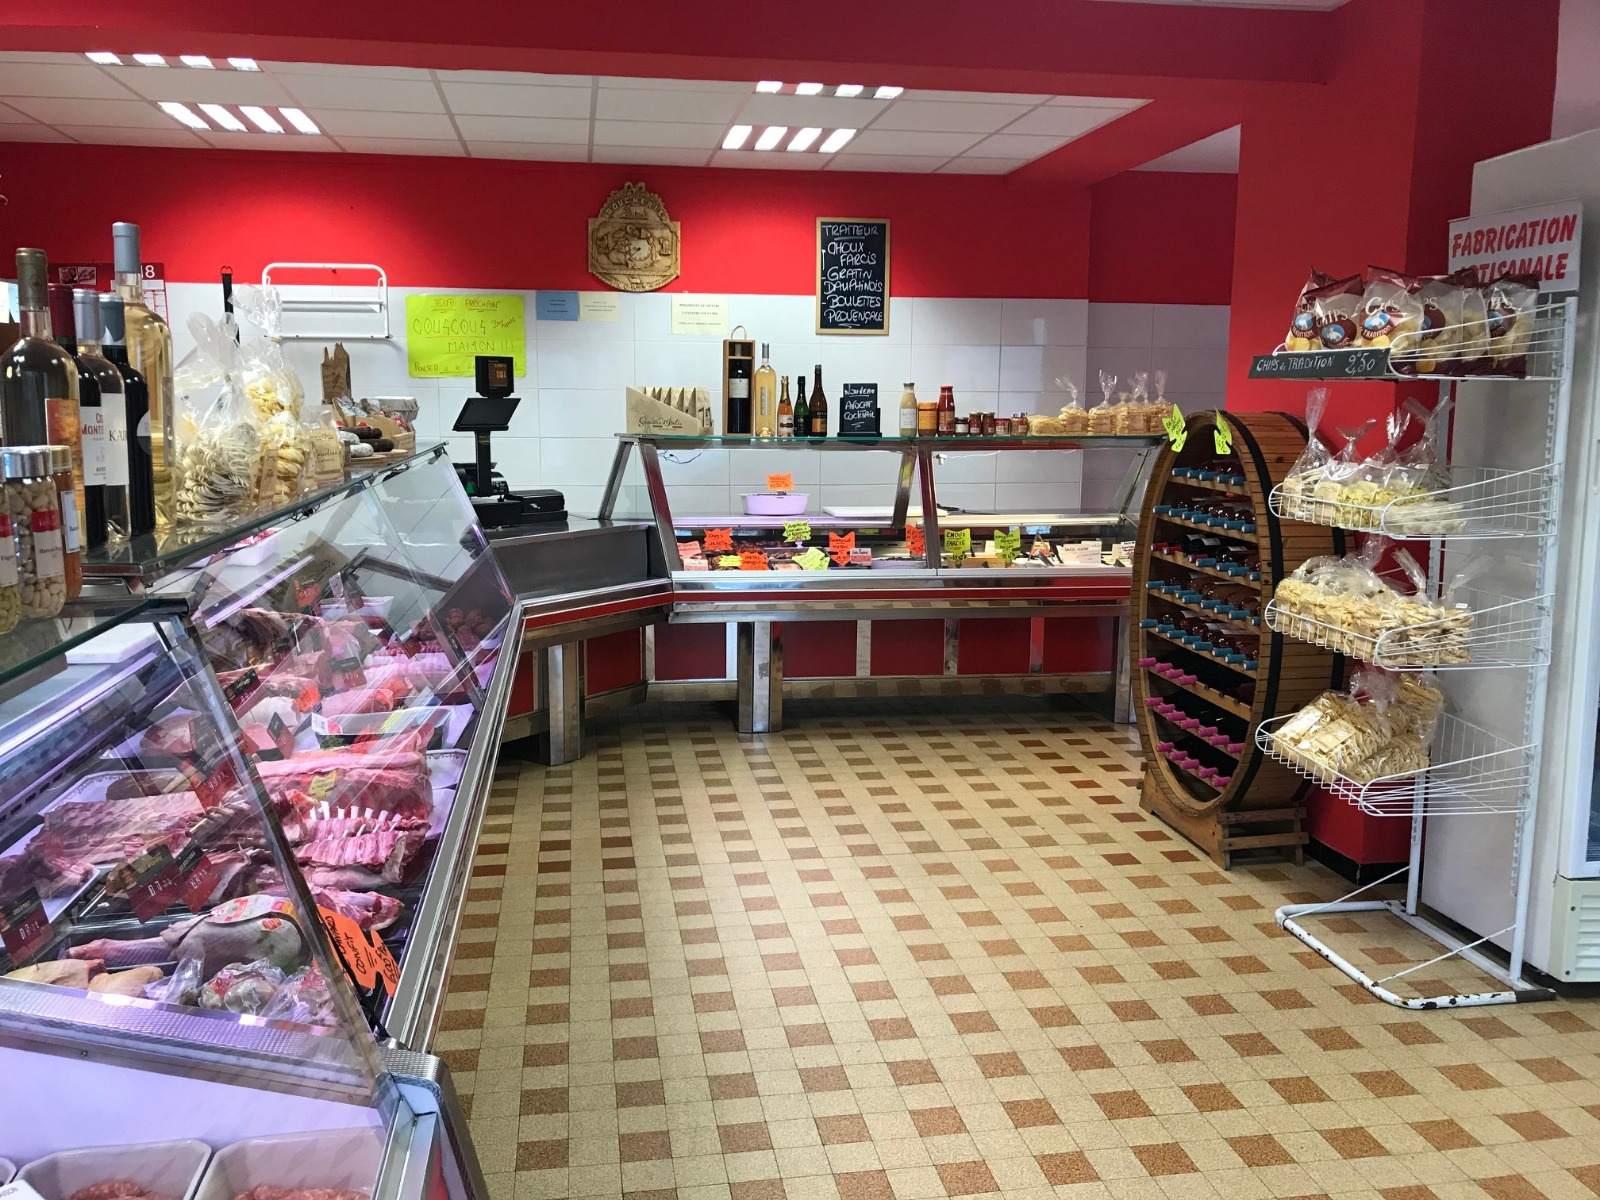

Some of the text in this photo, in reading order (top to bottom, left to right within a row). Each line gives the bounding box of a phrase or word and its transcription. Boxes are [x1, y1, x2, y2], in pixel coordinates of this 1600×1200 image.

[1451, 213, 1578, 258] FABRICATION
[827, 241, 864, 255] CHOUX
[826, 266, 873, 281] GRATIN
[1470, 253, 1569, 284] TISANALE
[826, 294, 882, 308] BOULETTES
[413, 317, 486, 336] COUSCOUS
[1363, 324, 1392, 338] TRADITION
[448, 340, 495, 352] MAISON
[1256, 358, 1279, 372] CHIPS
[845, 400, 873, 410] AVOCAT
